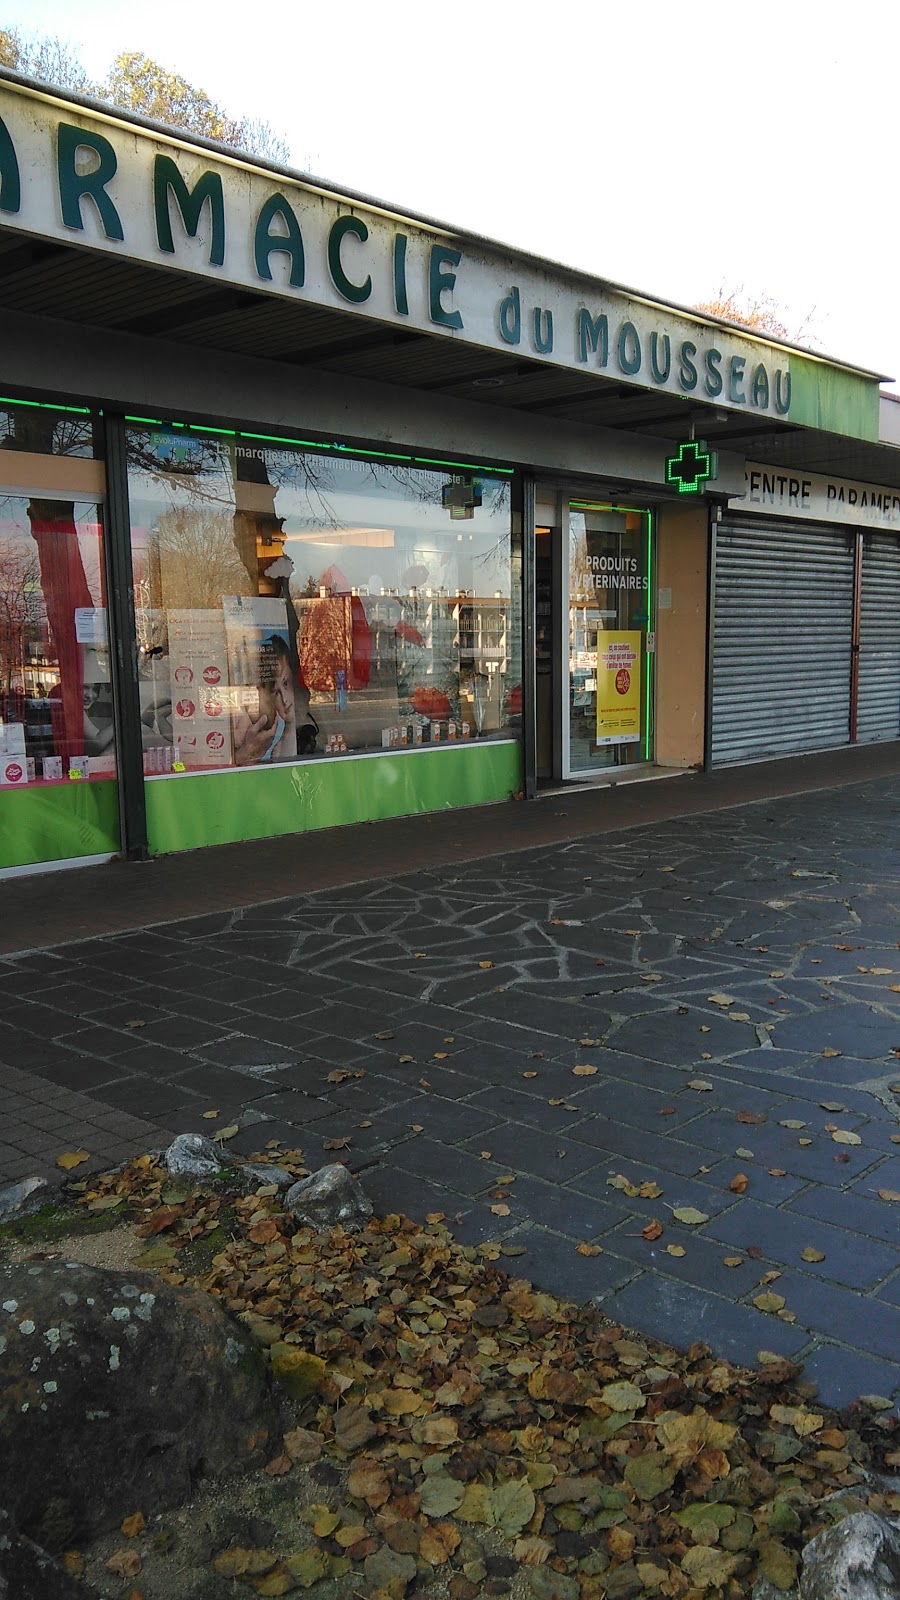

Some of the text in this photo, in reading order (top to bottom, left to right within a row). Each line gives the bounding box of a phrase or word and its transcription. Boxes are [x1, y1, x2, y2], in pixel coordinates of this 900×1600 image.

[499, 285, 554, 354] du
[577, 306, 792, 415] MOUSSEAU
[215, 441, 232, 456] La
[234, 445, 279, 463] marque
[304, 452, 371, 474] Pharmaciens
[744, 471, 812, 510] ENTRE
[585, 555, 638, 572] PRODUITS
[575, 572, 649, 590] VETERINAIRES
